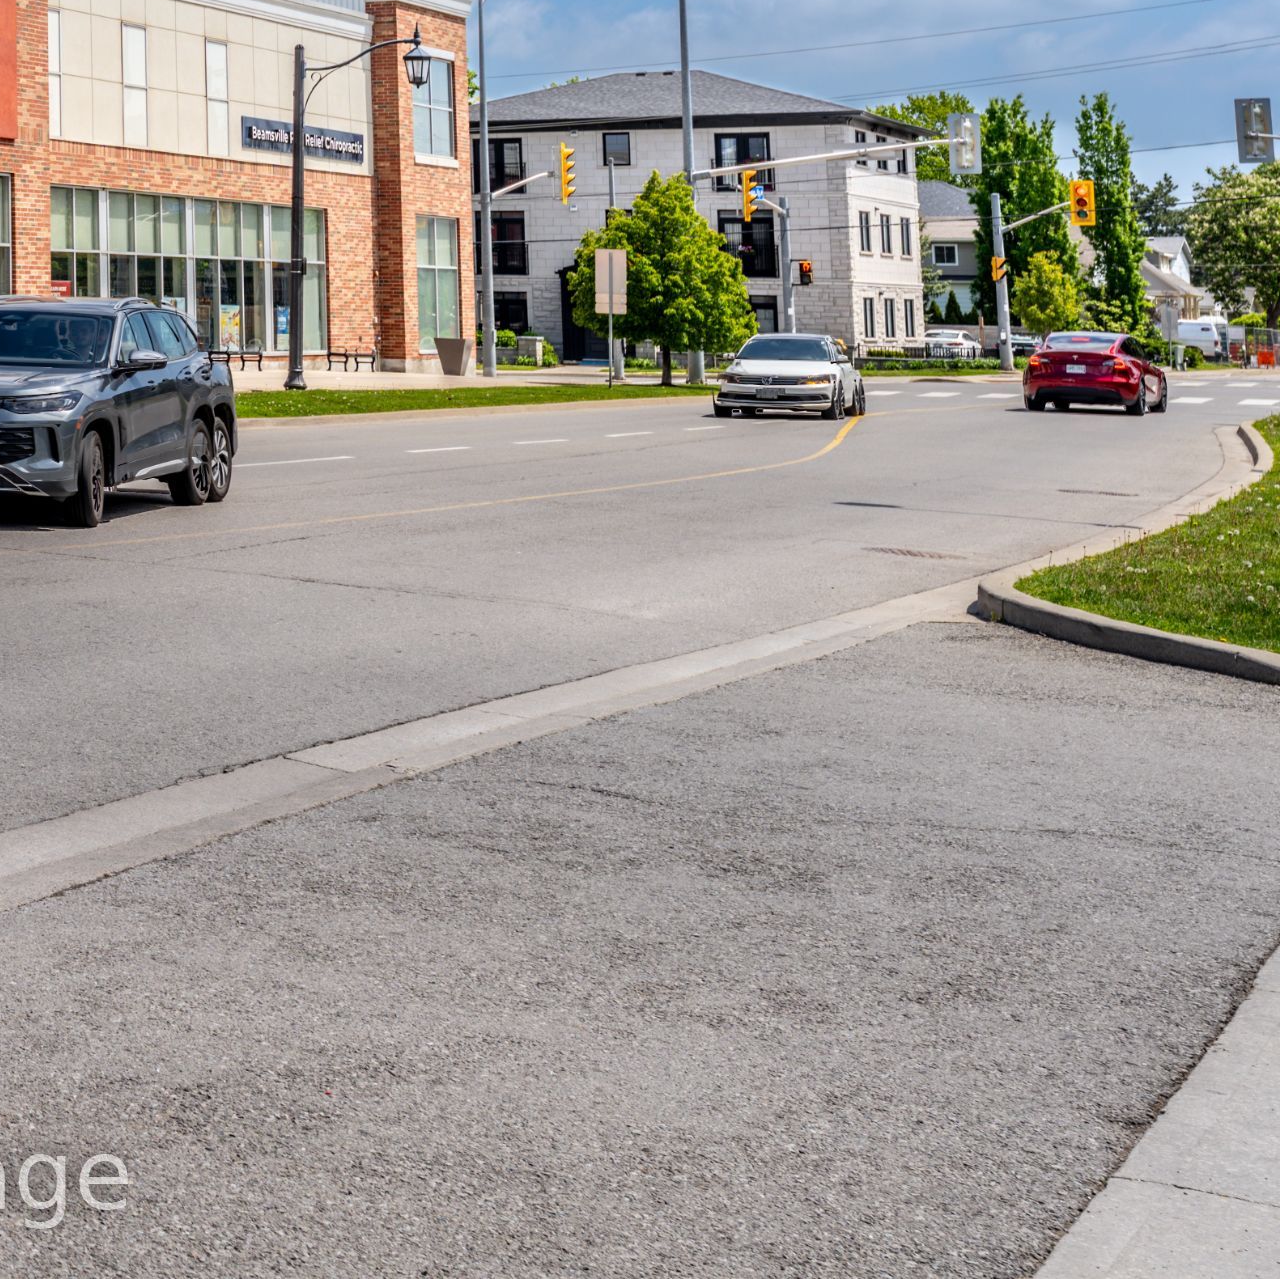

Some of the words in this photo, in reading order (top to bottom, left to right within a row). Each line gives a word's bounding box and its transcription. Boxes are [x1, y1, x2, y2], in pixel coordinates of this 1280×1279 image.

[251, 126, 289, 144] Beamsville
[305, 133, 324, 148] Relief
[324, 134, 363, 154] Chiropractic
